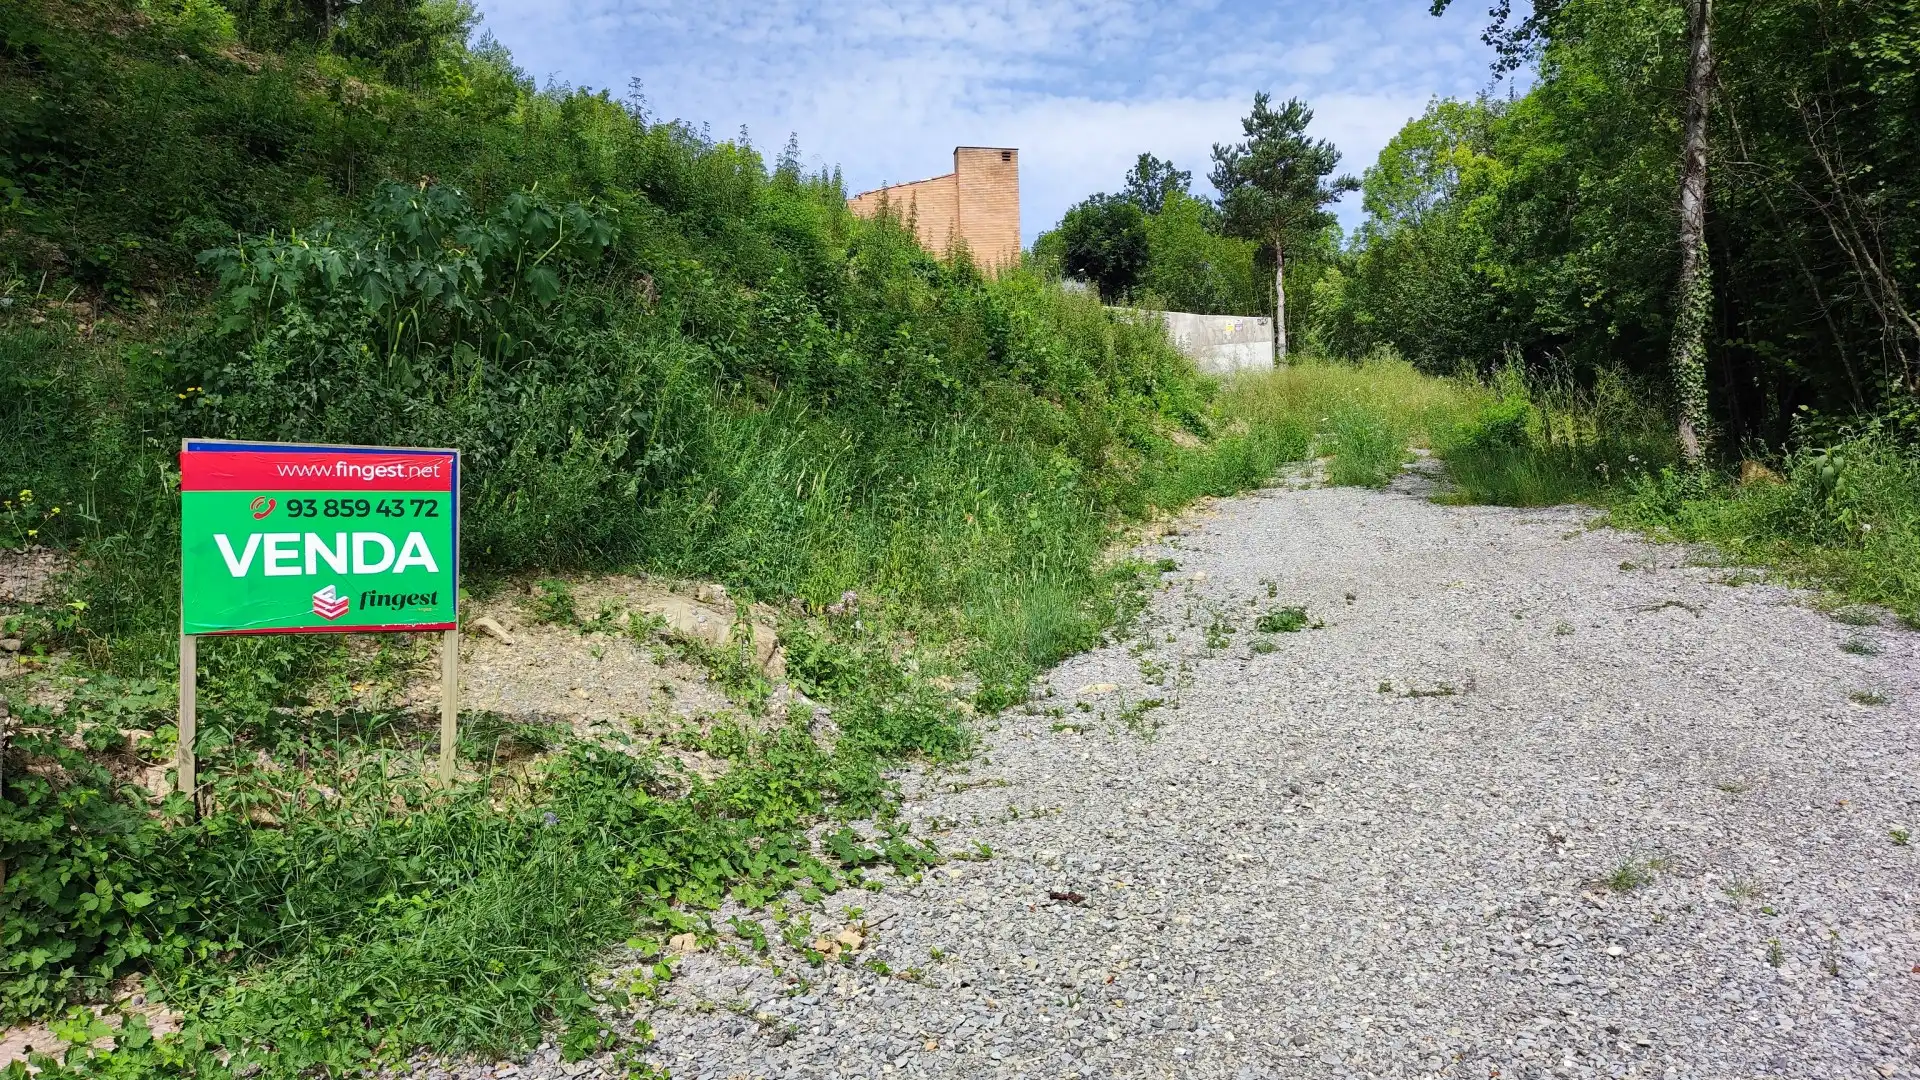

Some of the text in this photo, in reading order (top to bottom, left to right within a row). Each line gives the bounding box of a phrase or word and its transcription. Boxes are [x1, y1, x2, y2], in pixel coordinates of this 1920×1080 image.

[277, 461, 440, 480] www.fingest.net
[287, 499, 439, 518] 93 859 43 72
[213, 532, 439, 577] VENDA
[359, 590, 438, 610] fingest
